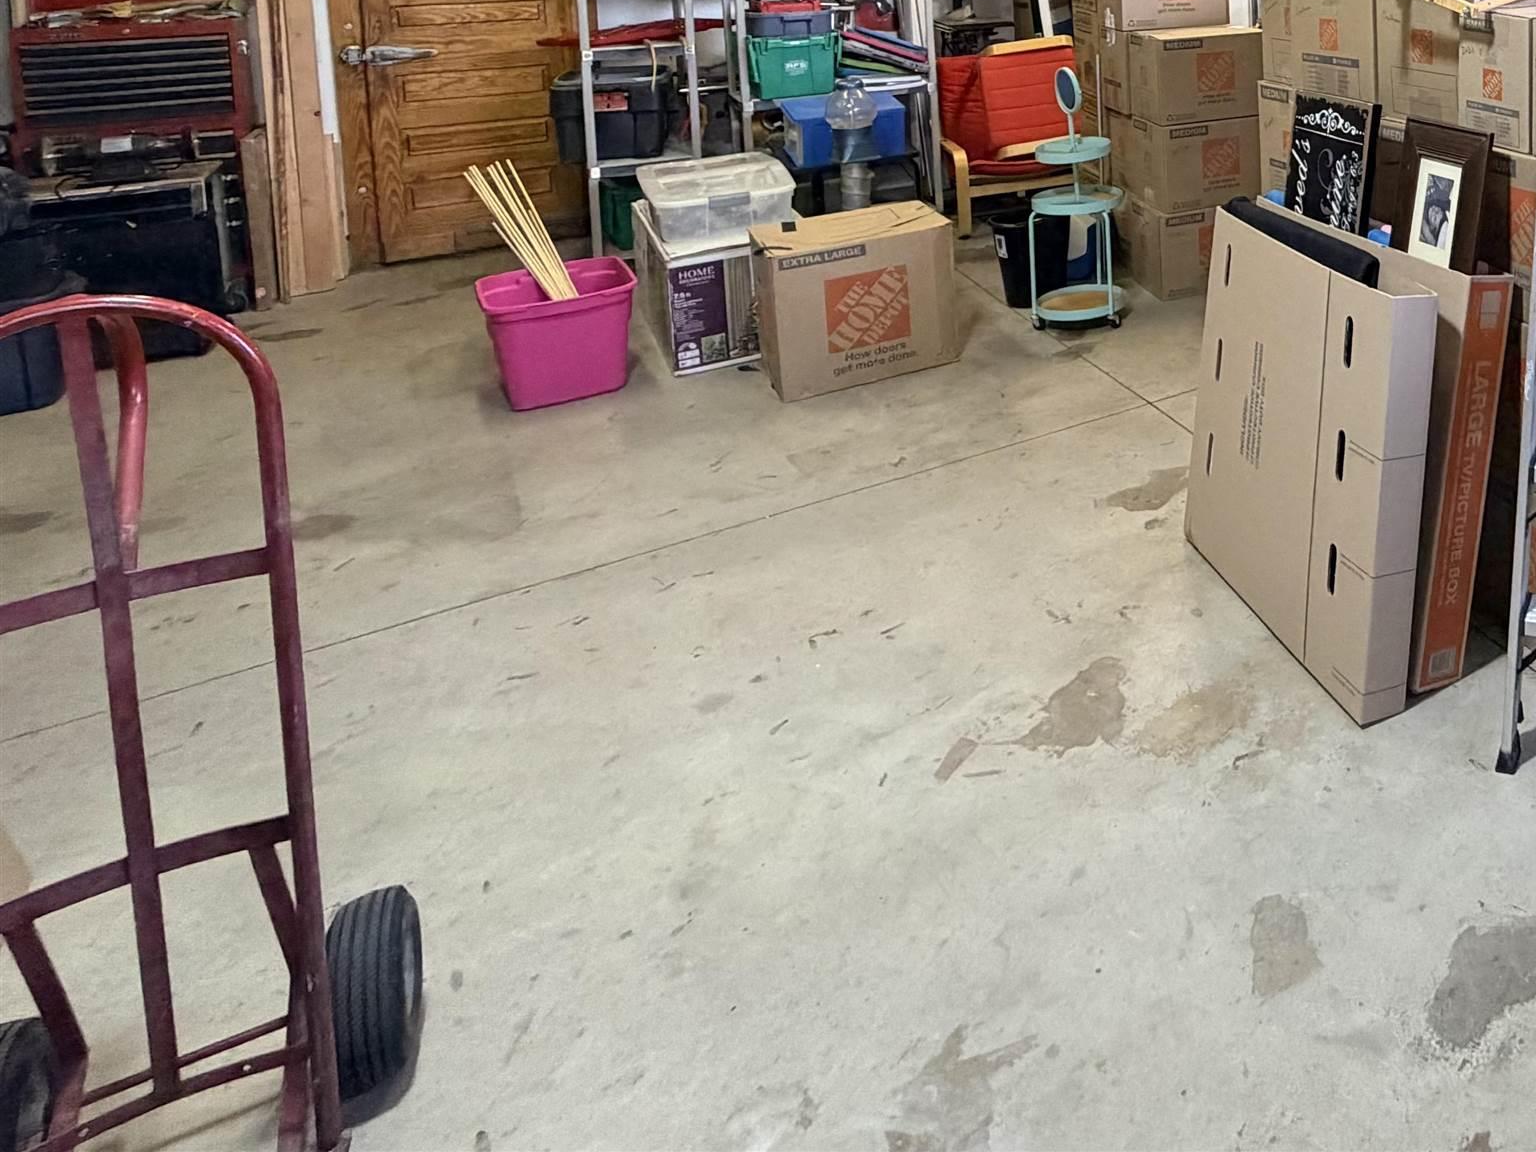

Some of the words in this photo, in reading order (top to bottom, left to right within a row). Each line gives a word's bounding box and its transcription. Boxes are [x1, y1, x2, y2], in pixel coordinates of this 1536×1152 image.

[678, 266, 716, 279] HOME
[782, 254, 822, 268] EXTRA
[824, 247, 863, 262] LARGE
[828, 266, 910, 349] HOME
[836, 280, 869, 313] THE
[862, 297, 909, 348] DEPOT
[845, 349, 870, 363] How
[873, 341, 907, 356] doers
[1465, 360, 1492, 448] LARGE
[1449, 452, 1477, 562] TV/PICTURE
[1443, 568, 1463, 606] BOX
